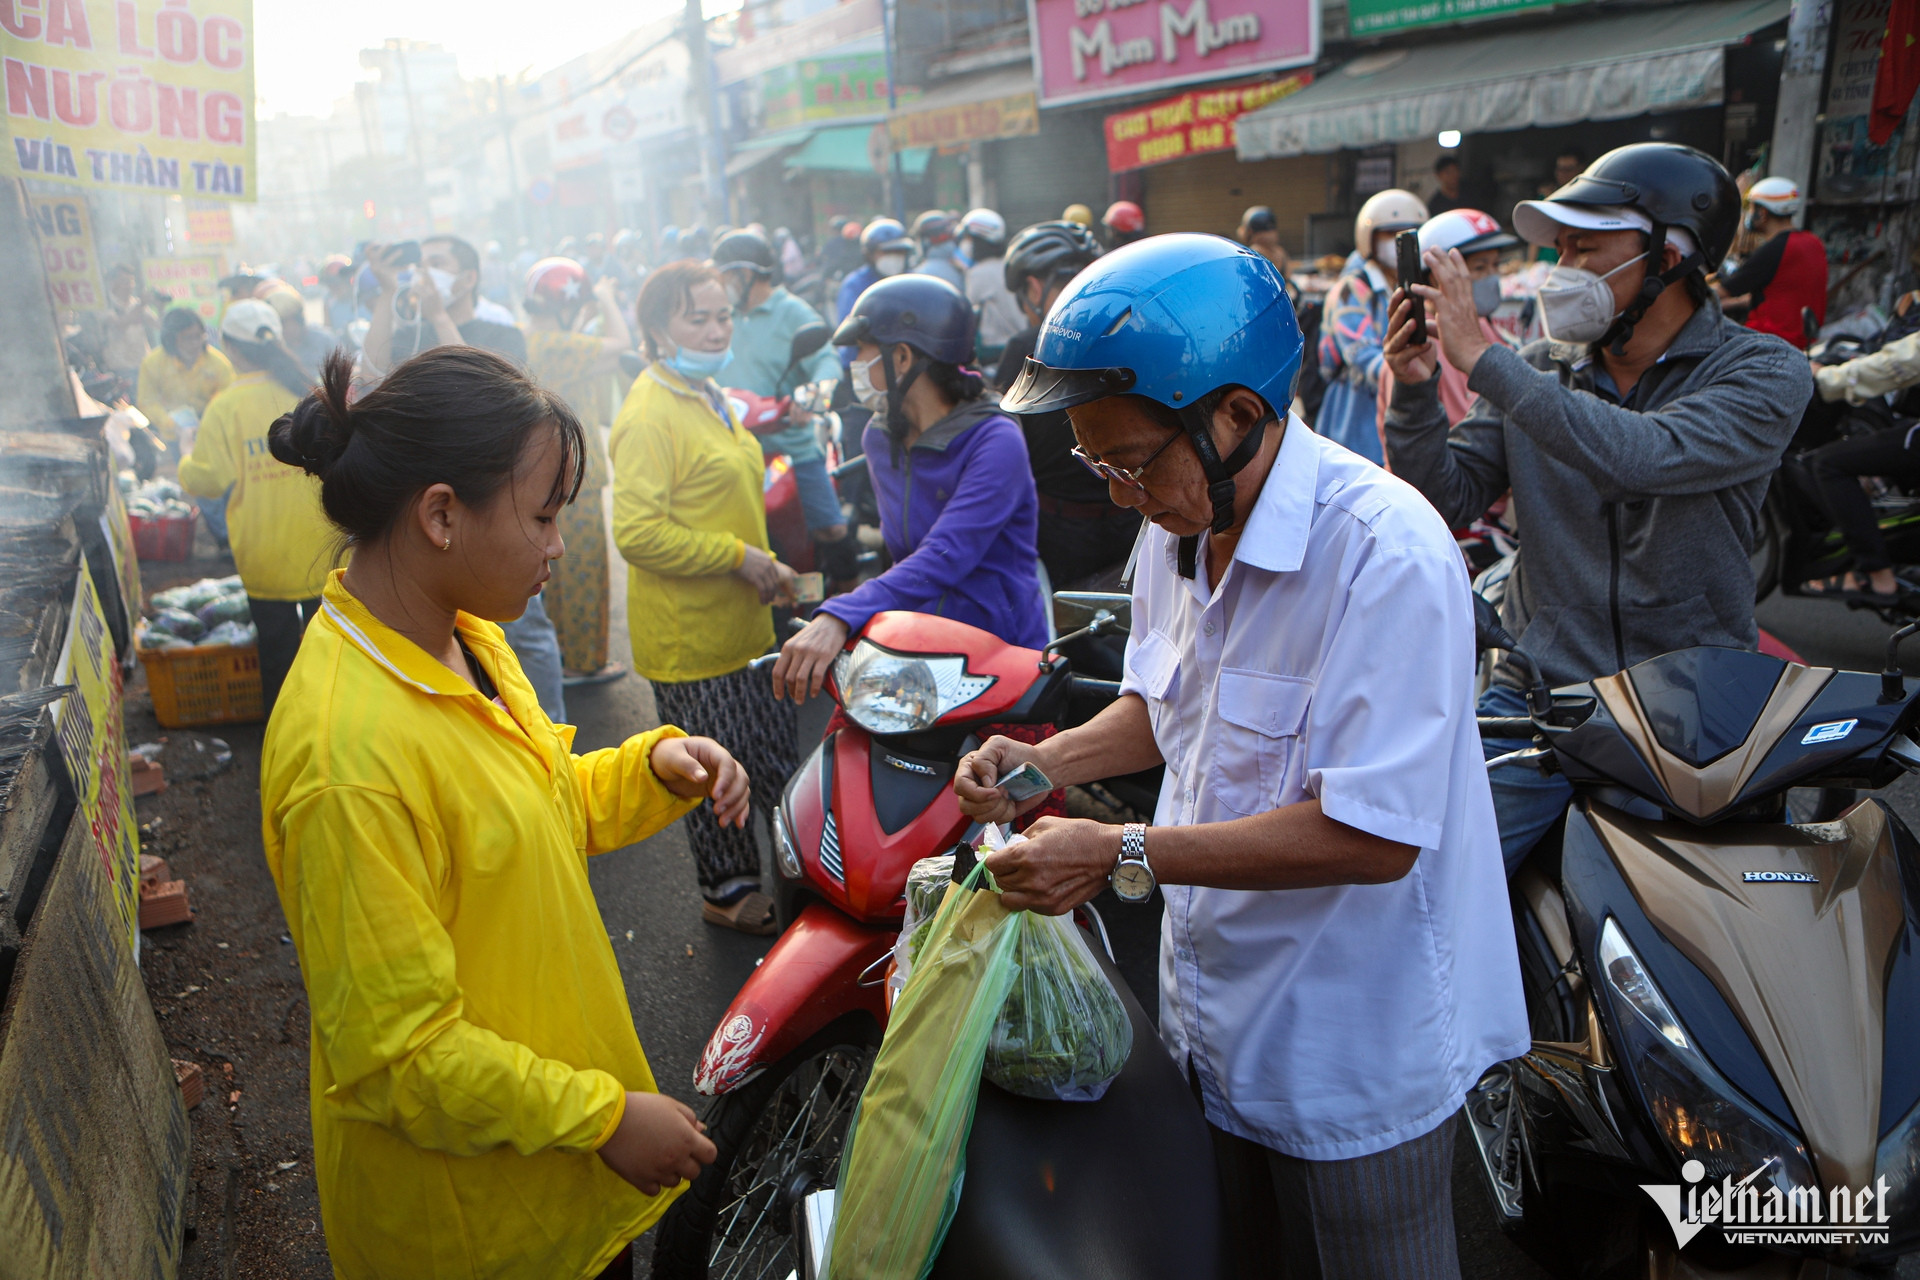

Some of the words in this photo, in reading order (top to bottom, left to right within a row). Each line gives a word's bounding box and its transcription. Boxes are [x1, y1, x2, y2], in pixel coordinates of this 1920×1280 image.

[1069, 19, 1154, 81] Mum
[1160, 0, 1259, 62] Mum
[4, 57, 245, 147] NƯỚNG
[14, 137, 78, 178] VÍA
[191, 157, 244, 196] TÀI
[1743, 871, 1820, 883] HONDA
